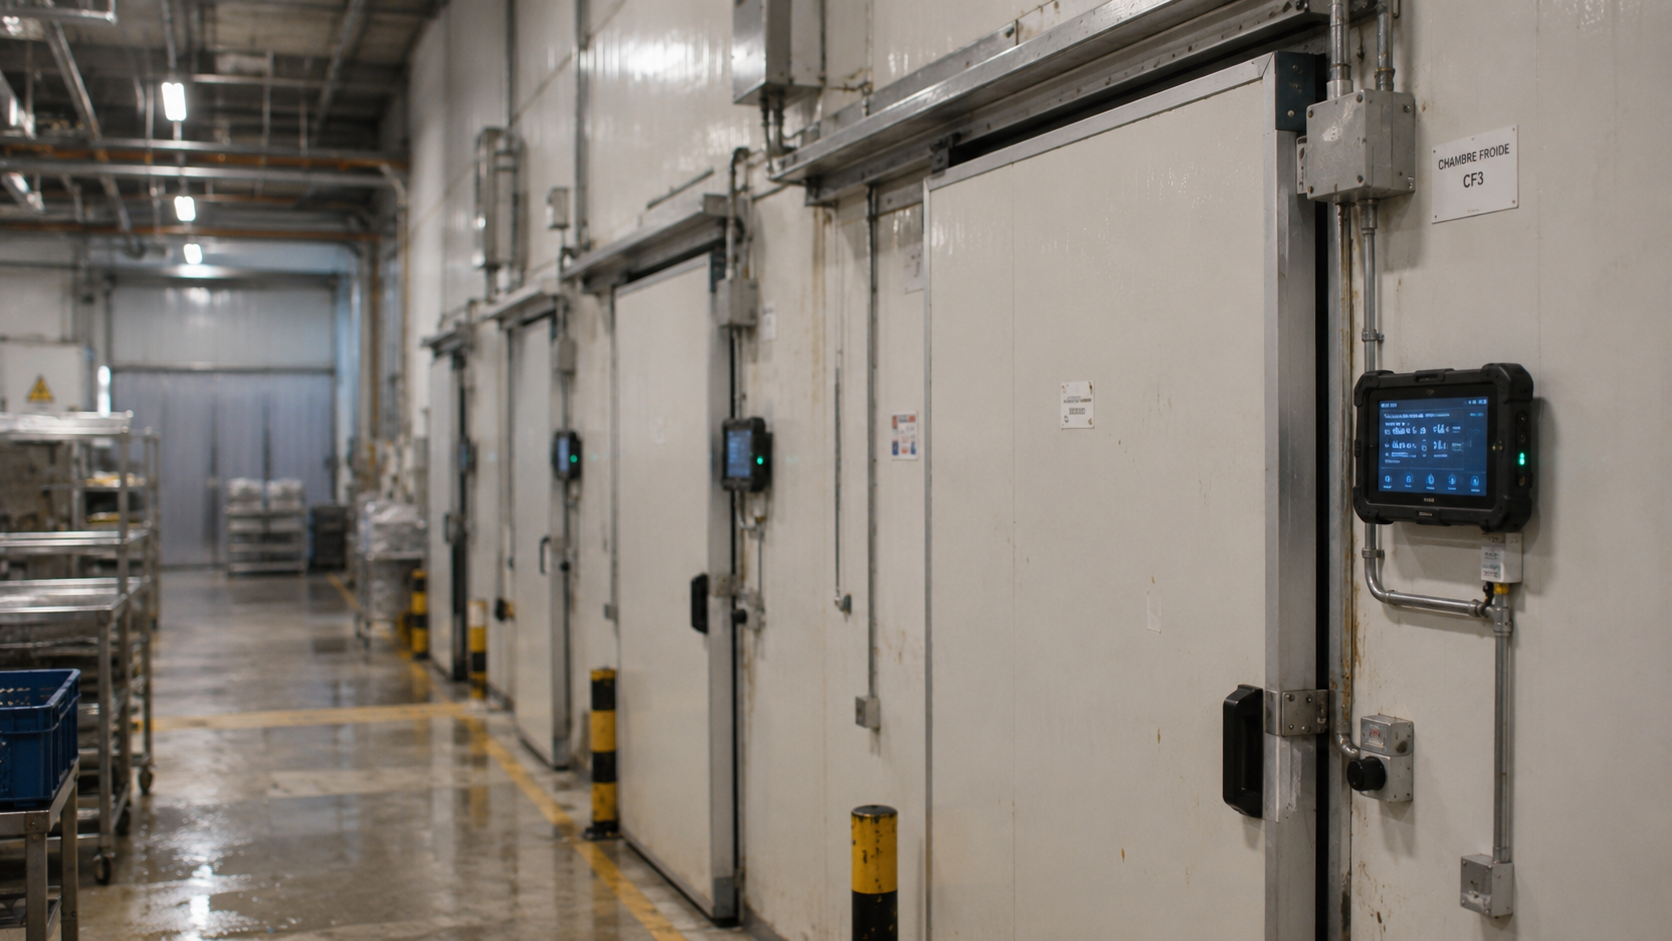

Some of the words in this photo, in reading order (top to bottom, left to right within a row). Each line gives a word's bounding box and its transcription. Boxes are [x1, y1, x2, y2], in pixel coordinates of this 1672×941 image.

[1438, 151, 1477, 170] CHAMBRE
[1479, 143, 1510, 160] FROIDE
[1463, 171, 1484, 188] CF3
